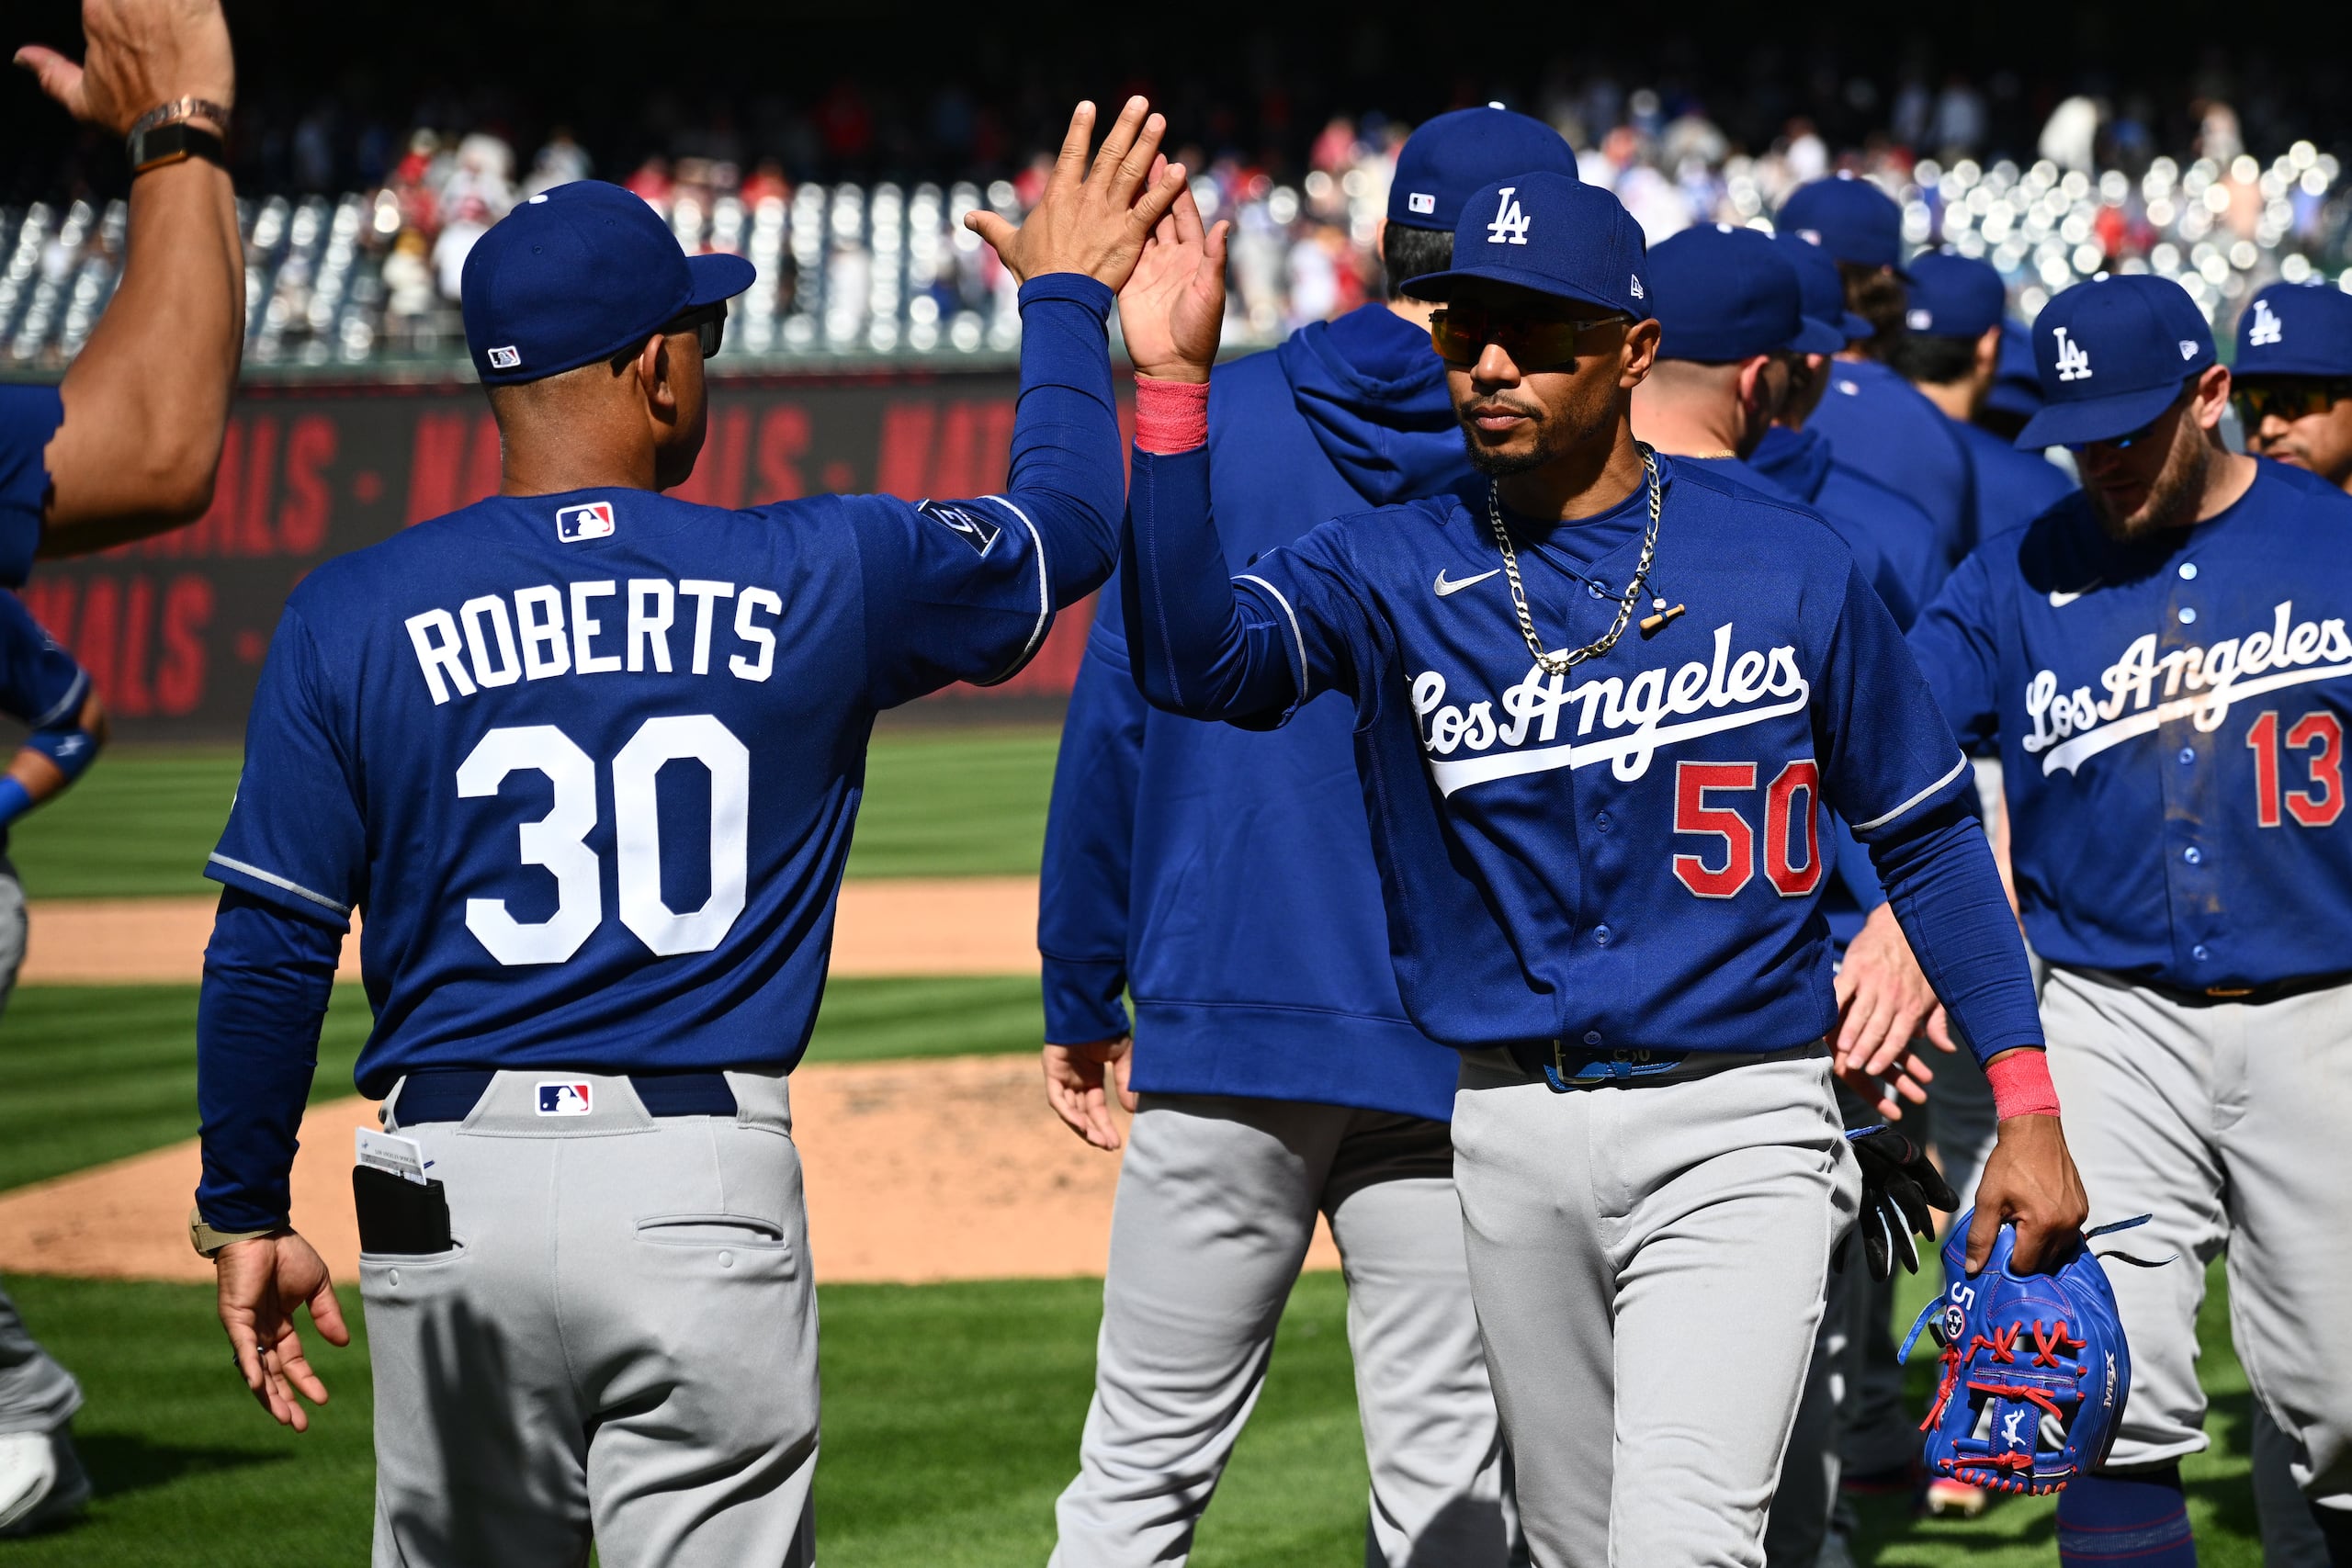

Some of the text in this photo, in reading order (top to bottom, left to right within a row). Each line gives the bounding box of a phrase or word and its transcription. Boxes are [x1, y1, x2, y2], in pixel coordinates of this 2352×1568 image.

[1487, 187, 1531, 244] LA
[2052, 327, 2093, 381] LA
[2248, 299, 2281, 345] LA
[404, 579, 783, 705] ROBERTS
[1405, 622, 1809, 782] Los Angeles
[2022, 600, 2352, 752] Los Angeles
[1673, 759, 1822, 899] 50
[2246, 709, 2345, 828] 13
[456, 714, 750, 965] 30
